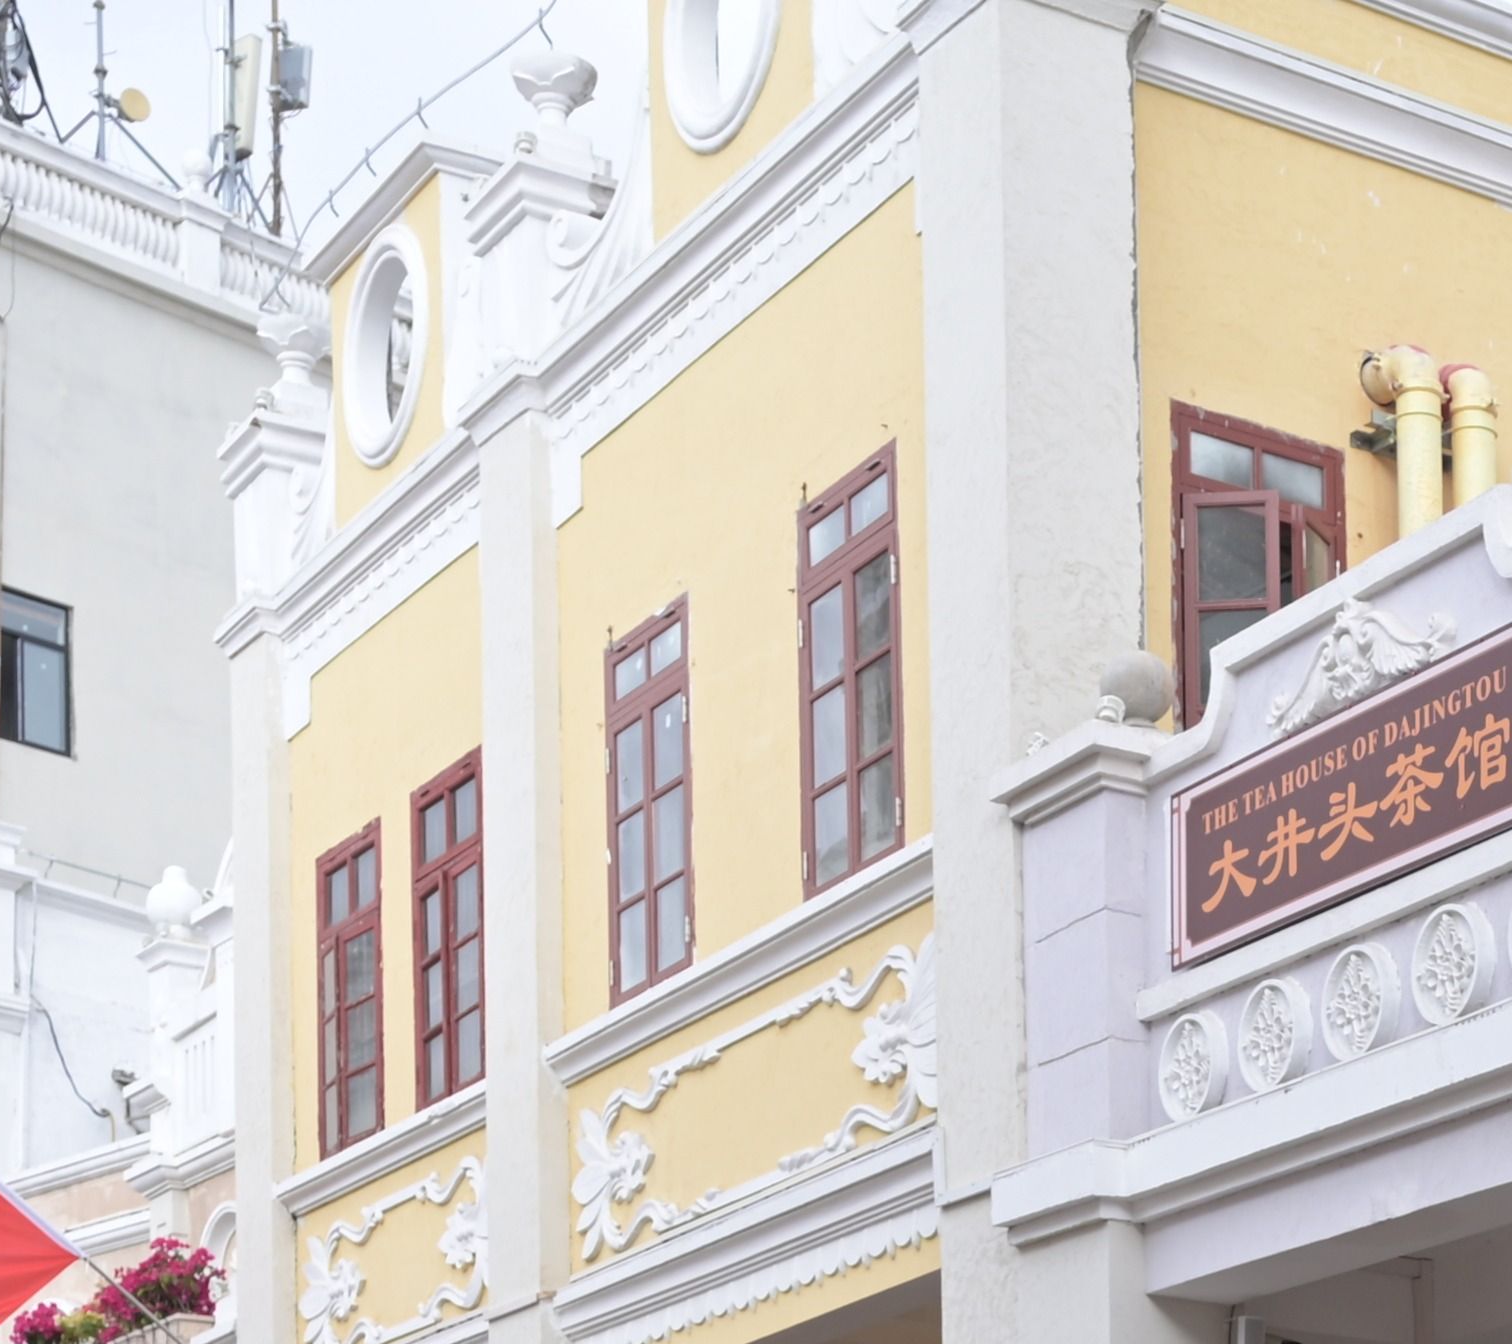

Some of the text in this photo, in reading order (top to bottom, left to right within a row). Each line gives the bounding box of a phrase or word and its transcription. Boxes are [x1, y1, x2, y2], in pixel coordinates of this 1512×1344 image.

[1202, 666, 1506, 835] THE TEA HOUSE OF DAJINGTOU
[1202, 713, 1511, 913] 大井头茶馆
